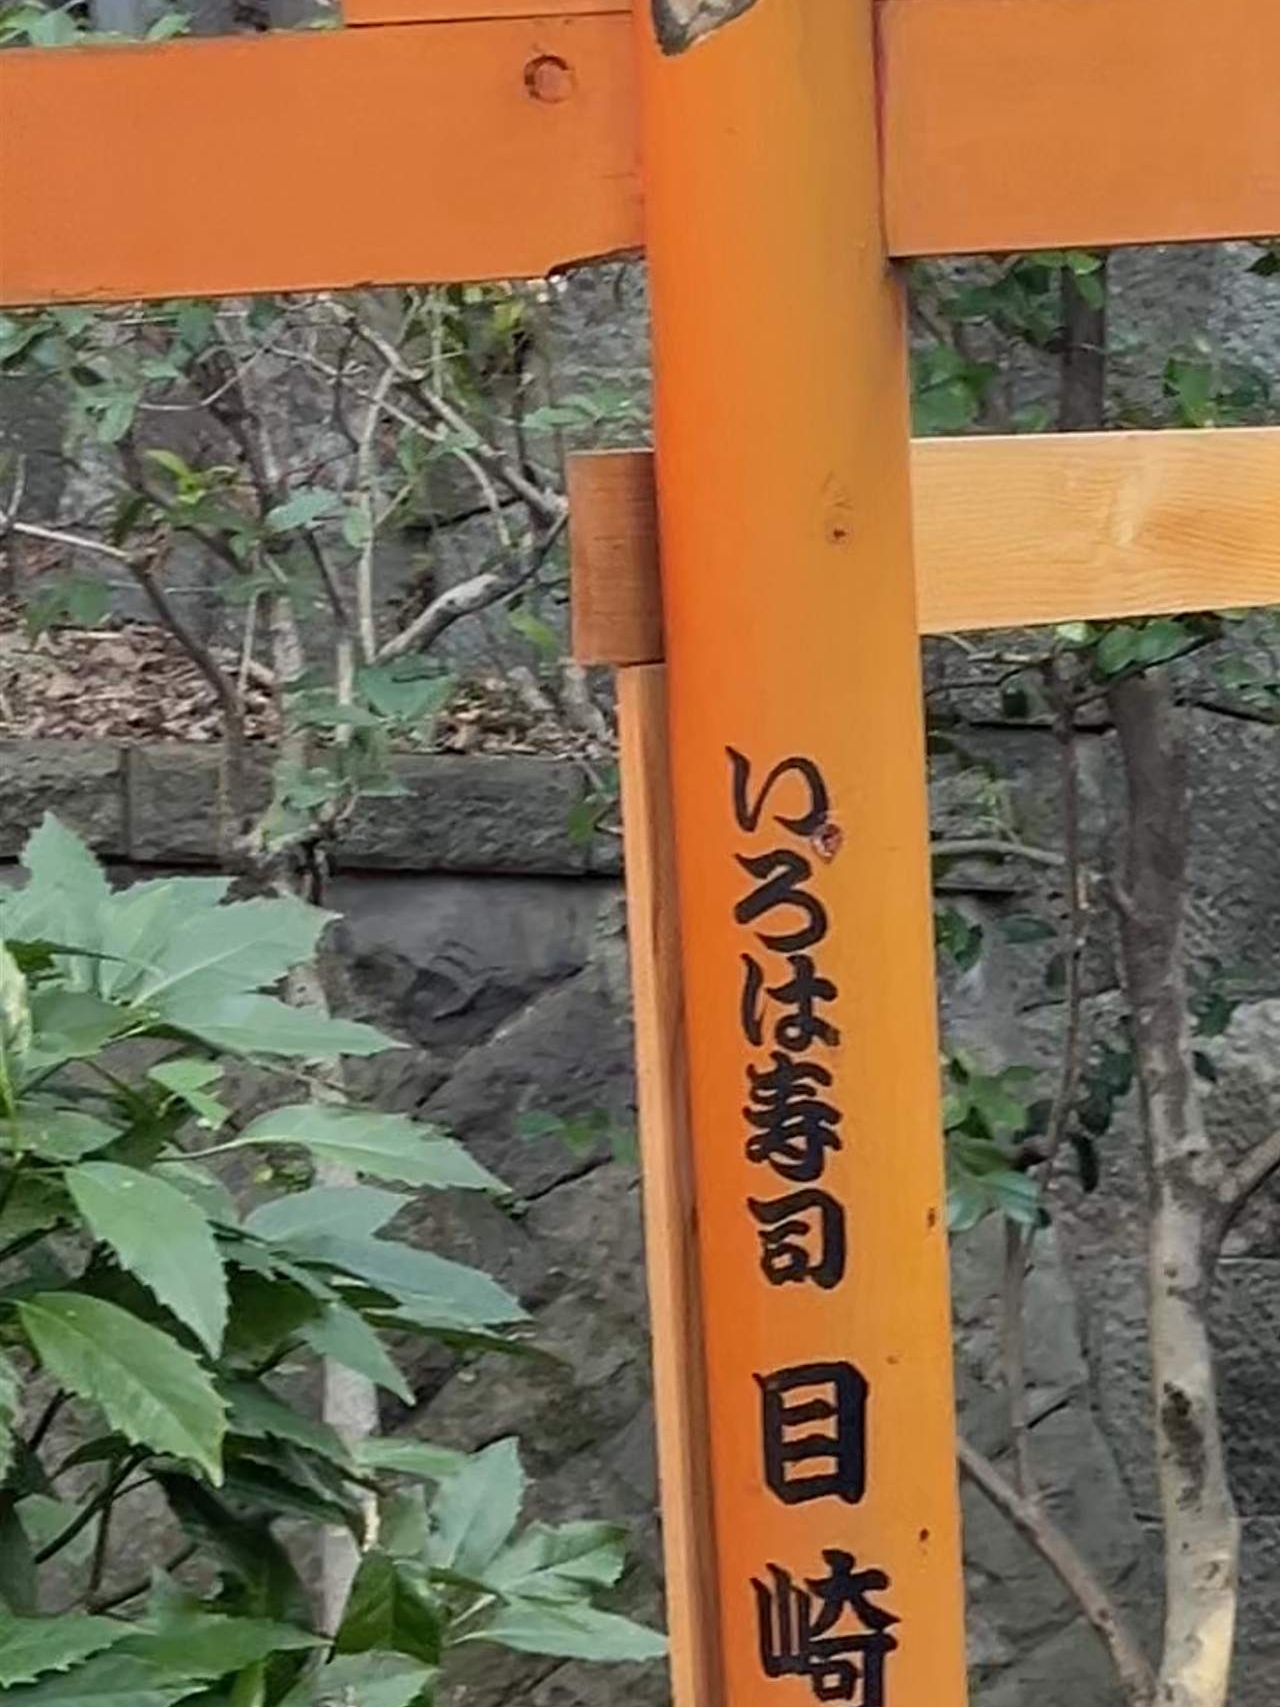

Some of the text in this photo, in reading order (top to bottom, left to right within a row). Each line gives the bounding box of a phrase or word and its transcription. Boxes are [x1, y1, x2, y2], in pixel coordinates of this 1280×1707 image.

[724, 745, 848, 1291] いろは寿司
